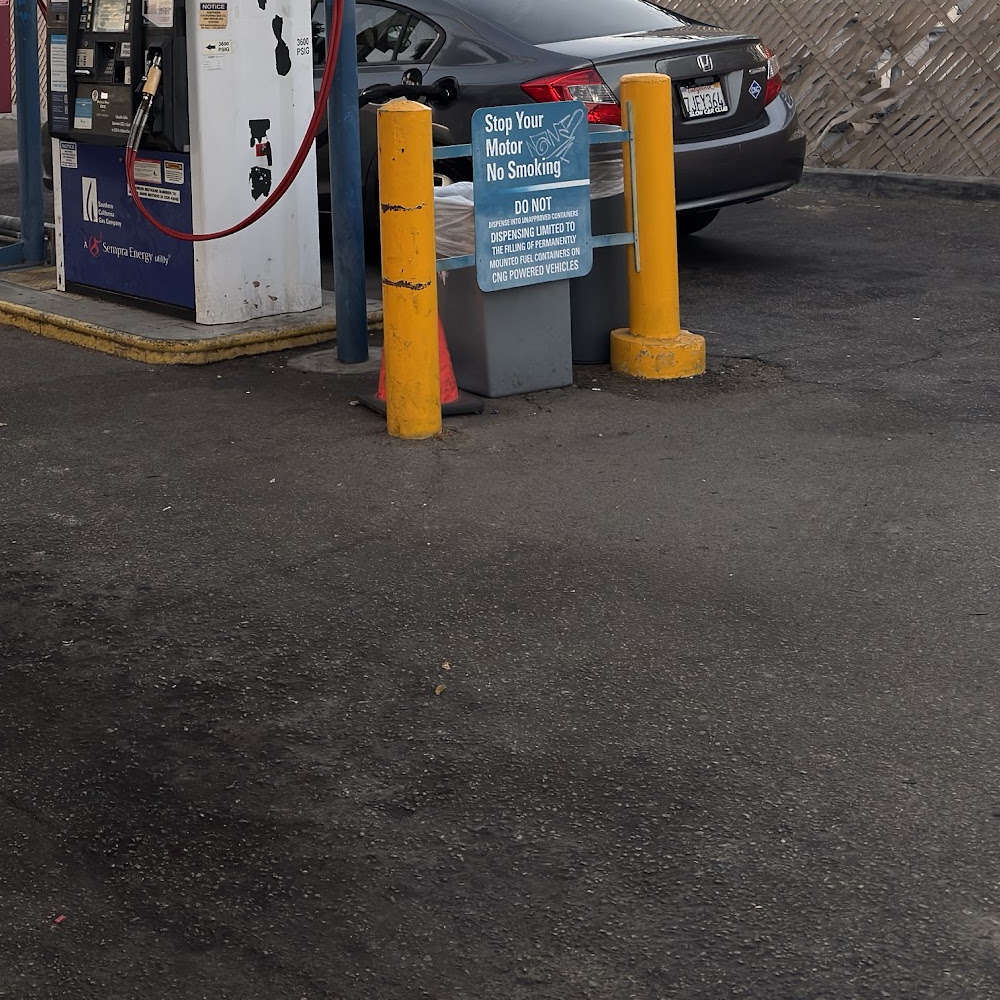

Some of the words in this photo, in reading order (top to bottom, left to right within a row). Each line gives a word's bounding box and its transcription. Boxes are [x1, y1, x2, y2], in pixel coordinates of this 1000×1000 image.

[297, 38, 309, 46] 3600
[297, 47, 310, 56] PSIG
[485, 114, 512, 136] Stop
[516, 111, 544, 130] Your
[486, 138, 523, 157] Motor
[486, 163, 504, 182] No
[508, 157, 560, 178] Smoking
[98, 201, 114, 209] Southern
[99, 209, 114, 217] California
[515, 200, 529, 214] DO
[532, 196, 552, 212] NOT
[106, 219, 122, 228] Company
[489, 219, 510, 229] DISPENSE
[510, 217, 521, 225] INTO
[522, 214, 551, 224] UNAPPROVED
[551, 210, 578, 220] CONTAINERS
[491, 227, 534, 243] DISPENSING
[536, 223, 564, 236] LIMITED
[565, 221, 575, 232] TO
[102, 242, 128, 257] Sempra
[129, 247, 153, 263] Energy
[492, 246, 504, 255] THE
[505, 242, 526, 254] FILLING
[527, 241, 534, 250] OF
[535, 235, 576, 249] PERMANENTLY
[490, 256, 518, 269] MOUNTED
[520, 254, 534, 264] FUEL
[535, 249, 570, 262] CONTAINERS
[572, 247, 580, 256] ON
[492, 271, 508, 283] CNG
[509, 265, 544, 280] POWERED
[546, 260, 579, 274] VEHICLES
